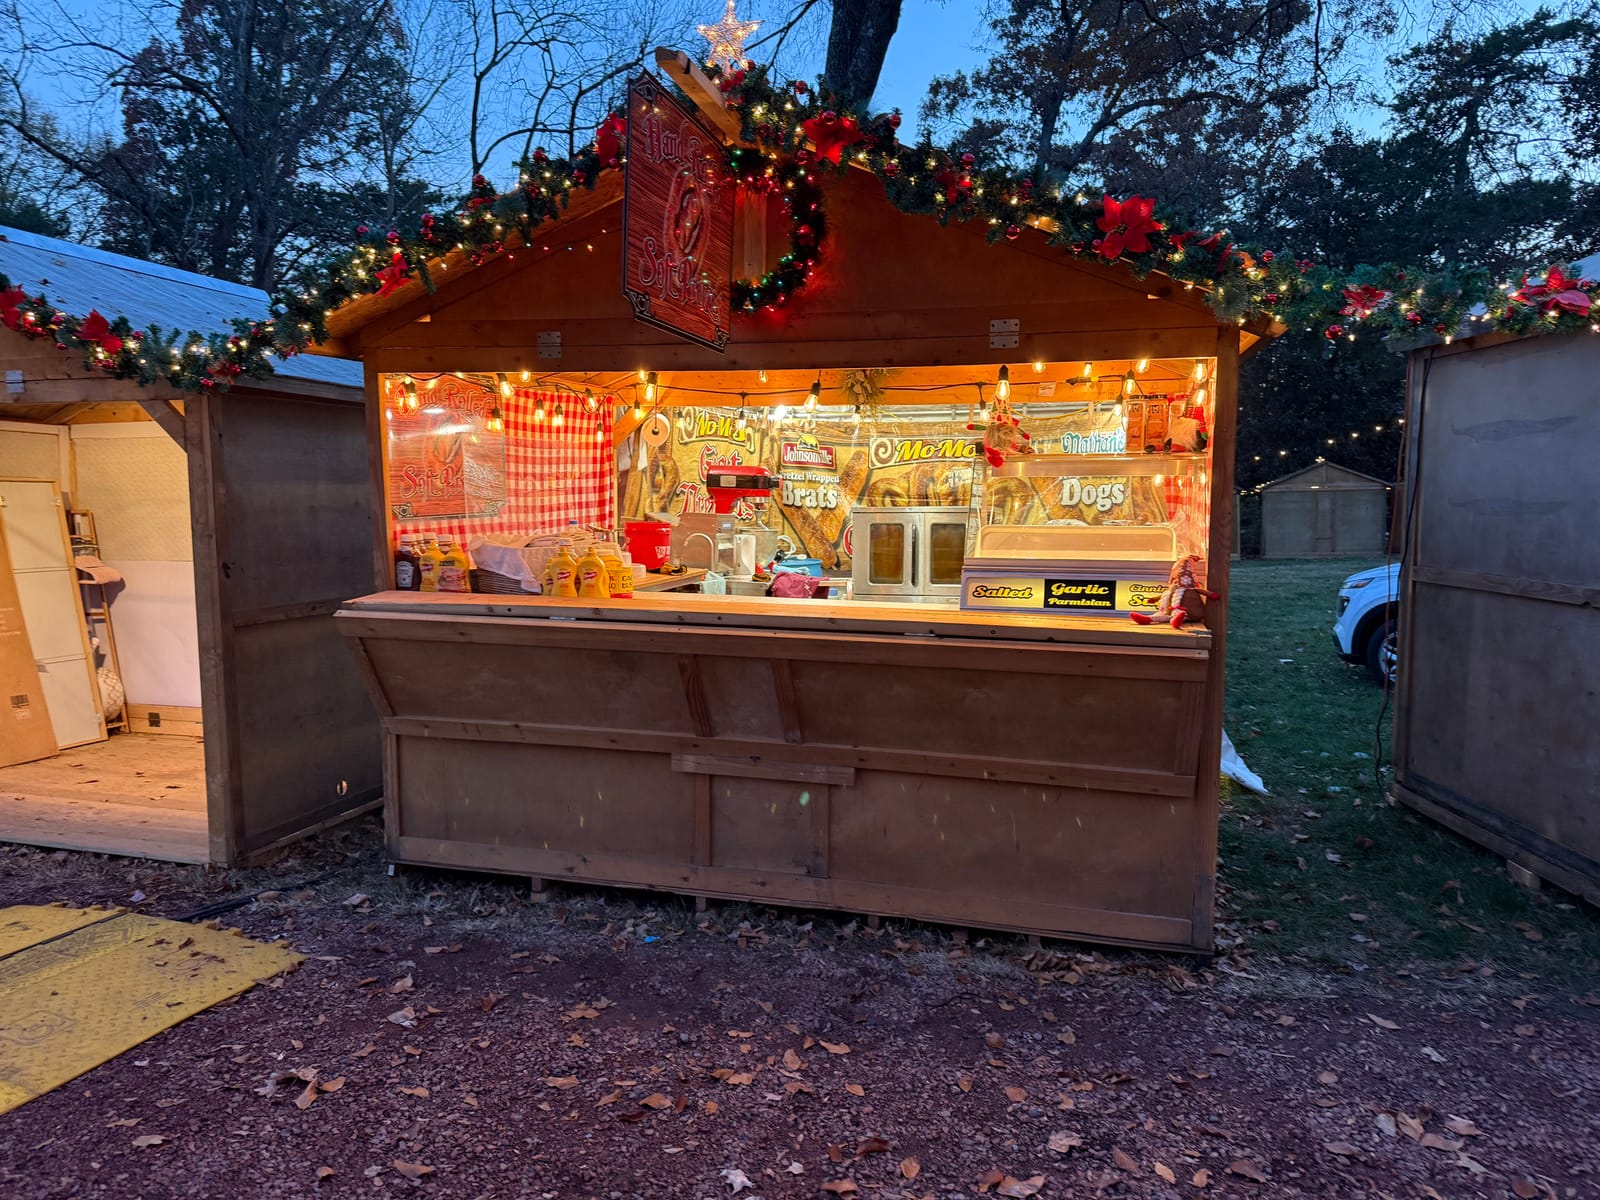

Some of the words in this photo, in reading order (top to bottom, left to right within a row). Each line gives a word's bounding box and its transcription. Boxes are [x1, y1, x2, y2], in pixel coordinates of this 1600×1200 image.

[639, 236, 680, 301] Soft
[784, 446, 833, 465] Johnsonville
[806, 472, 840, 484] Wrapped
[782, 480, 838, 509] Brats
[1061, 478, 1126, 512] Dogs
[972, 584, 1034, 600] Salted
[1050, 582, 1111, 596] Garlic
[1047, 597, 1113, 607] Parmisian
